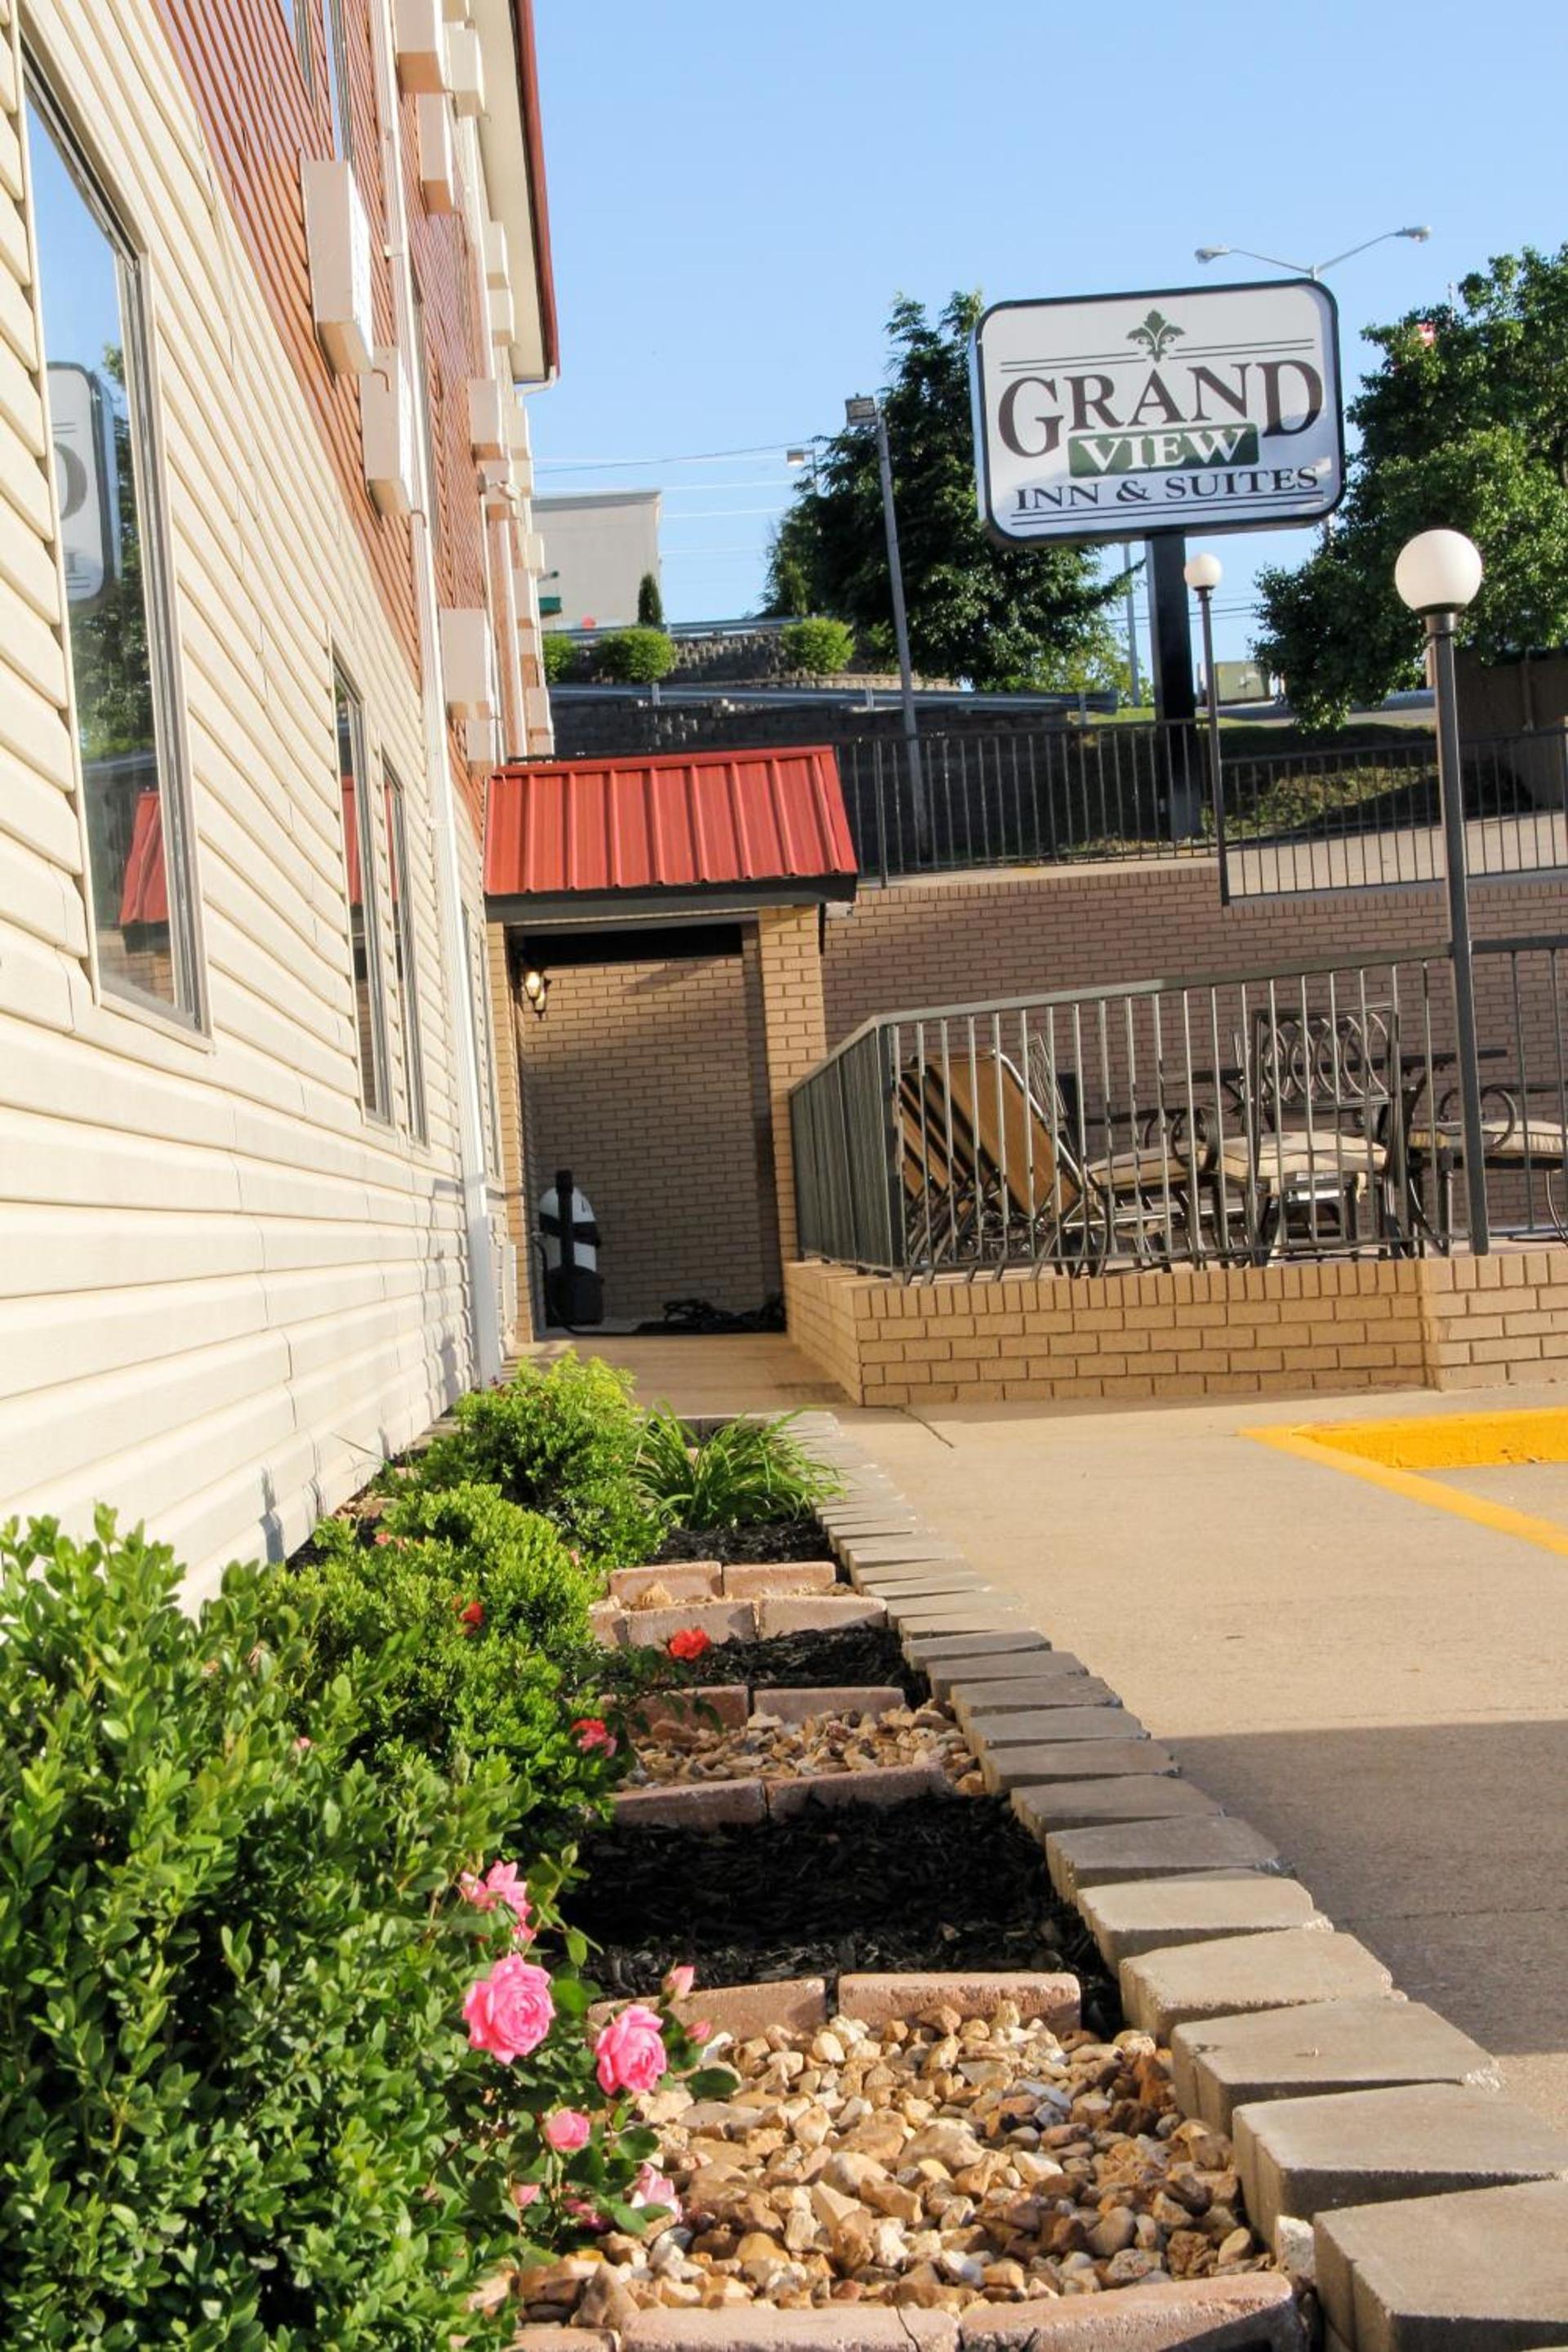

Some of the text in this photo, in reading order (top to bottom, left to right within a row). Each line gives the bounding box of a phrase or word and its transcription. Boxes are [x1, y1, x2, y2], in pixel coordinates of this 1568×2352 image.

[998, 359, 1323, 457] GRAND
[1079, 428, 1247, 473] VIEW
[1017, 466, 1318, 510] INN & SUITES
